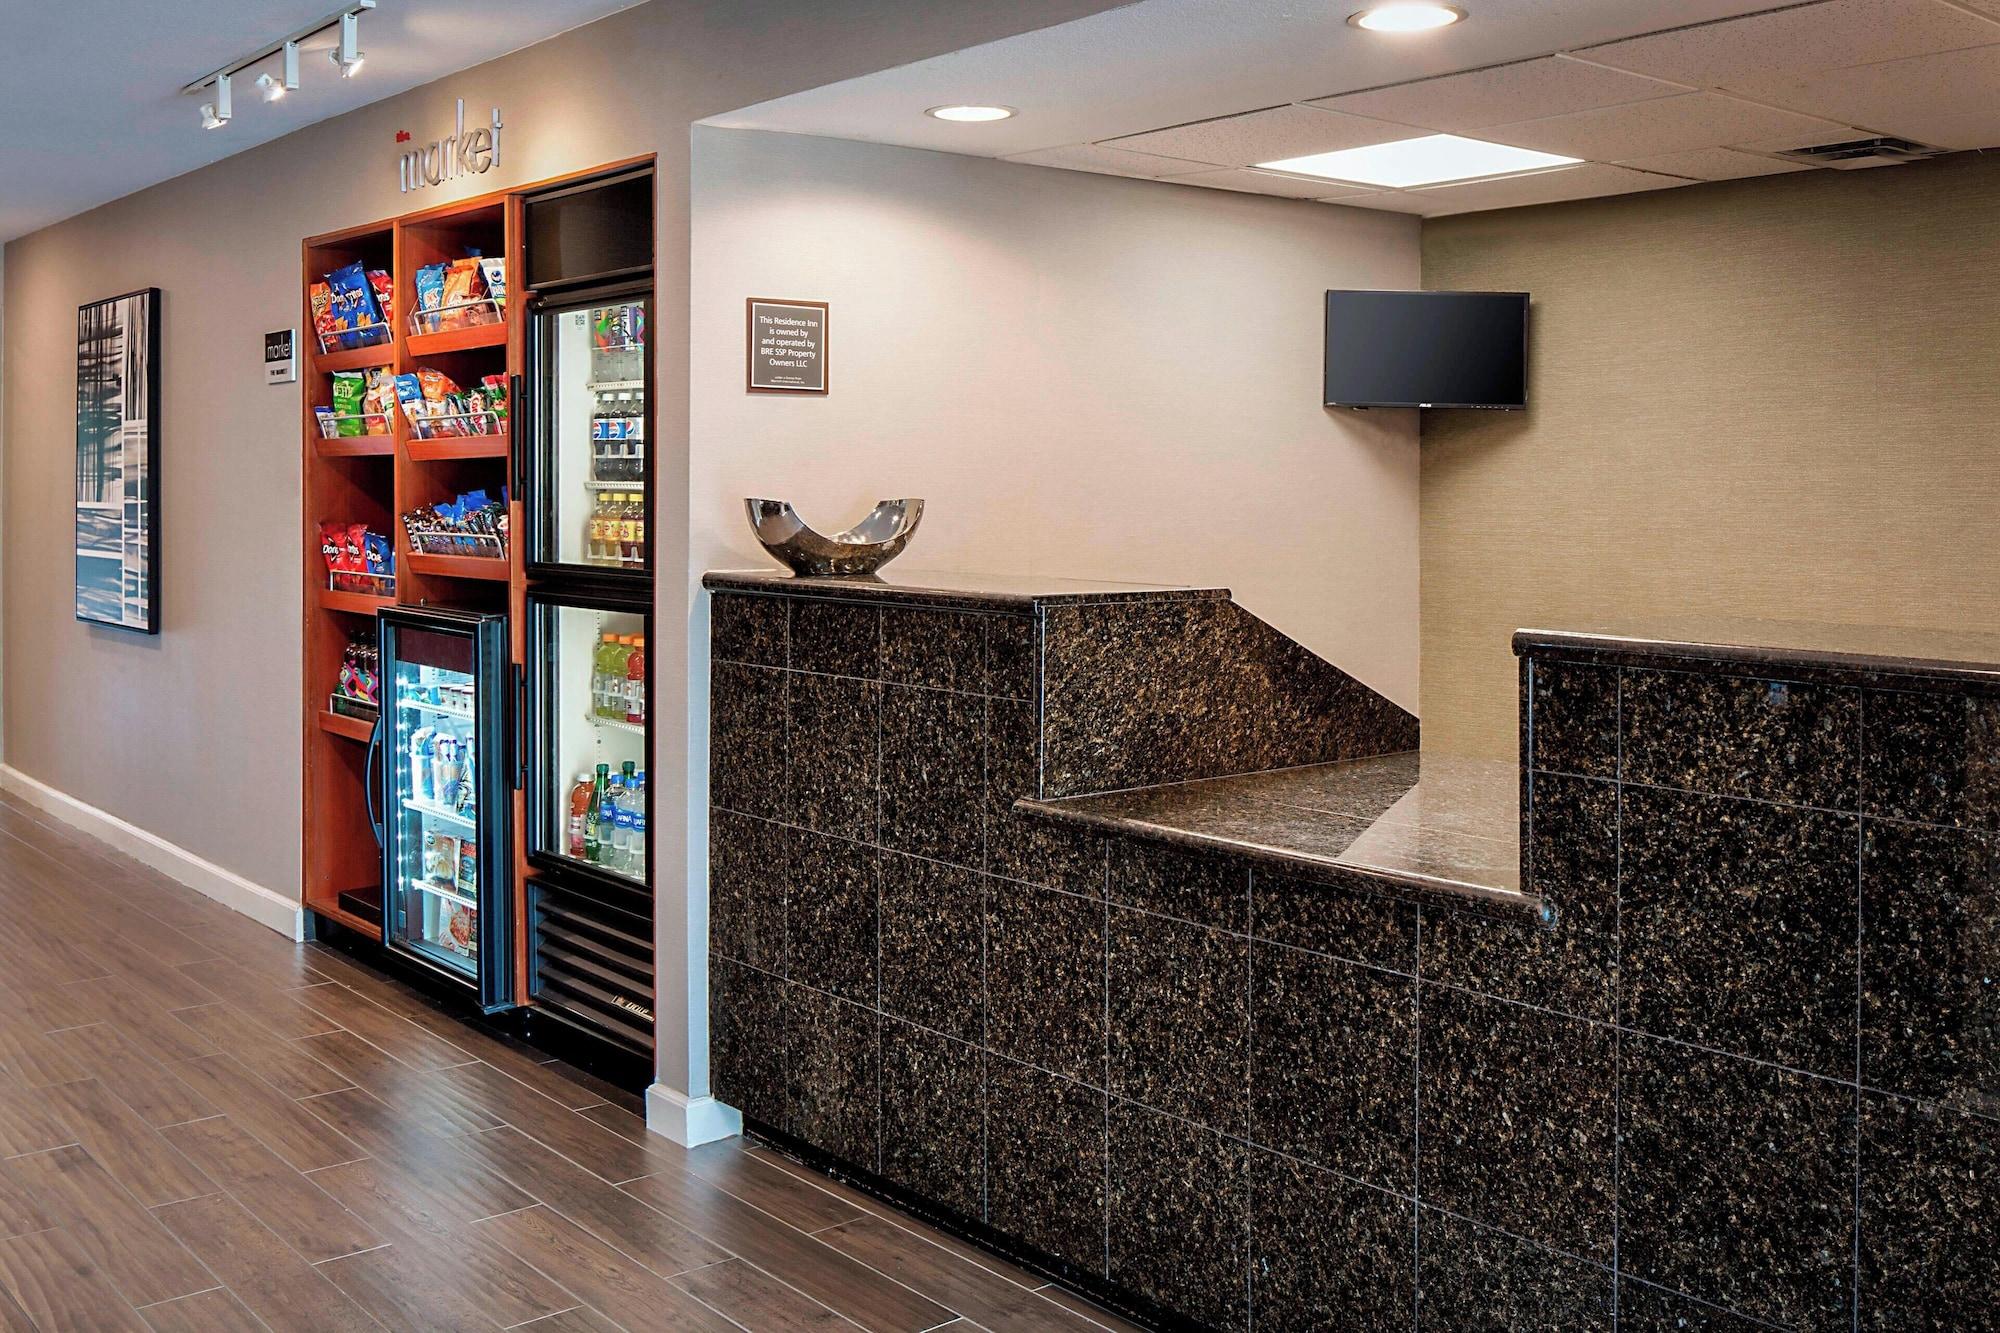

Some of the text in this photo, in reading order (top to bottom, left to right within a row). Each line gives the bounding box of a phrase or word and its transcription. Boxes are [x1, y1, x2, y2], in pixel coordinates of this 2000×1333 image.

[400, 98, 503, 194] market
[760, 316, 818, 328] This Residence Inn
[769, 327, 809, 339] is owned by
[775, 338, 806, 348] operated
[807, 340, 816, 350] by
[760, 347, 816, 360] BRE SSP Property
[769, 358, 808, 368] Owners LLC
